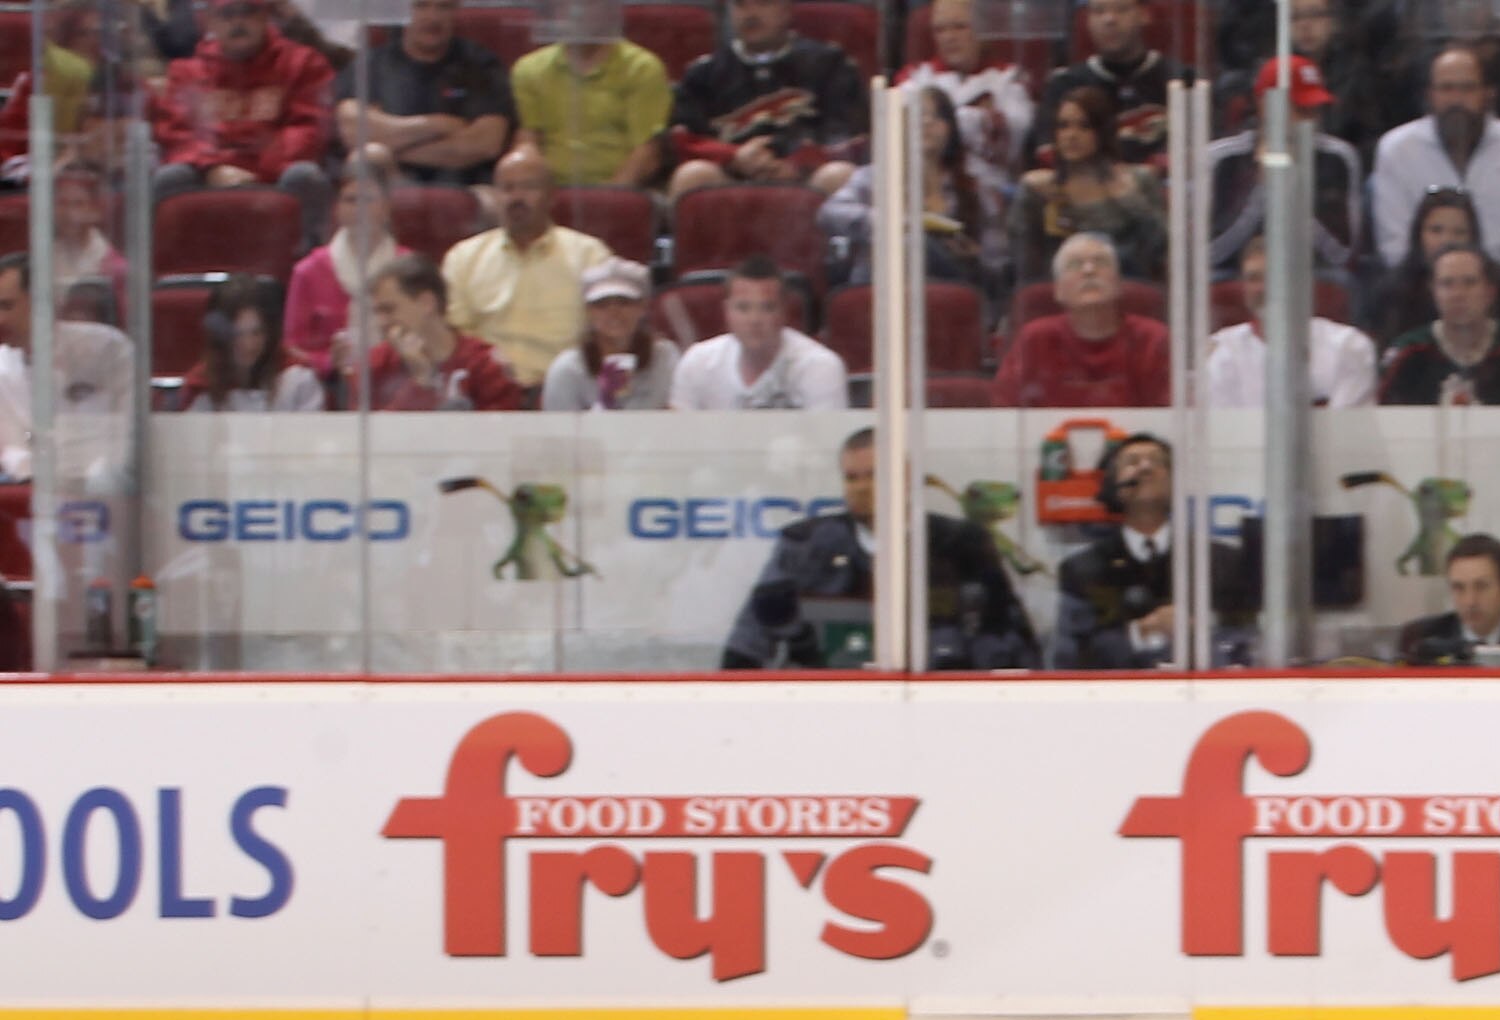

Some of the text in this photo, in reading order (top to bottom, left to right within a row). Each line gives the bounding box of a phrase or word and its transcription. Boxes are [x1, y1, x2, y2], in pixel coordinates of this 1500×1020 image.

[177, 499, 410, 541] GEICO
[628, 496, 846, 539] GEIC
[517, 800, 892, 836] FOOD STORES
[1254, 797, 1404, 832] FOOD
[381, 710, 936, 984] fry's
